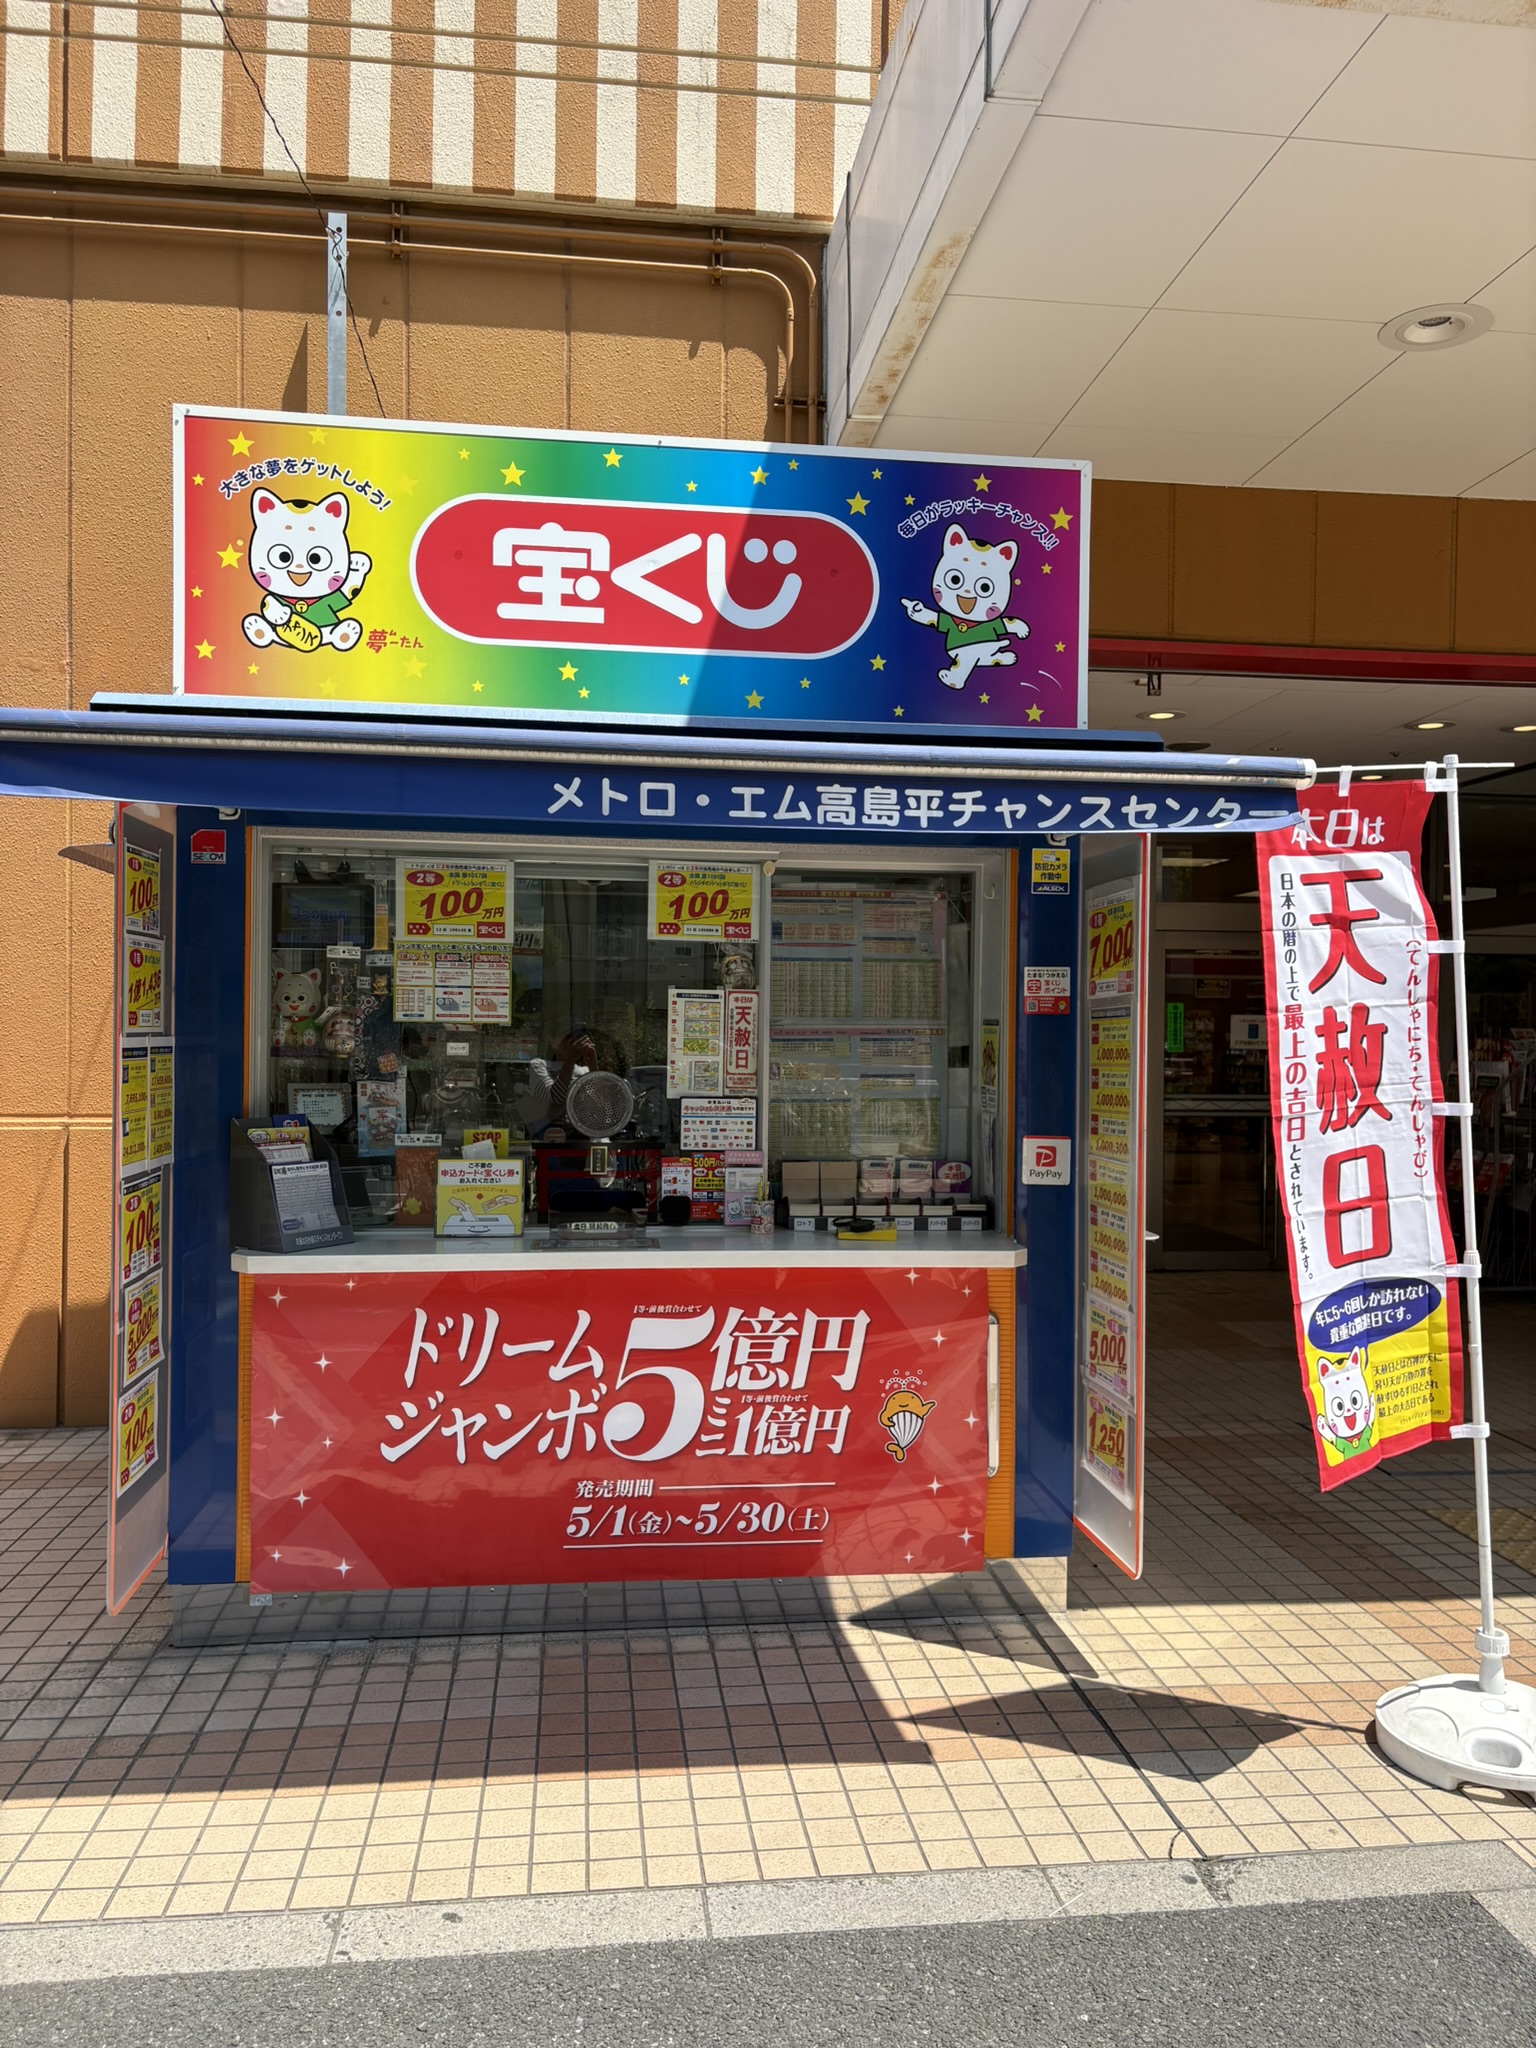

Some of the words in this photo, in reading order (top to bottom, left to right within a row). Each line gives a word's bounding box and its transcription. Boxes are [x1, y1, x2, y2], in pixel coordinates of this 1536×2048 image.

[492, 521, 803, 630] 宝くじ
[546, 776, 1290, 832] メトロ・エム高島平チャンスセンター
[1291, 808, 1385, 849] 本日は
[192, 853, 224, 861] SECOM
[1034, 863, 1068, 871] 防犯カメラ
[1040, 872, 1062, 880] 作動中
[479, 925, 504, 934] 宝くじ
[726, 926, 750, 935] 宝くじ
[734, 1006, 752, 1069] 天赦日
[1279, 872, 1314, 1280] 日本の暦の上で最上の吉日とされています。
[1300, 868, 1393, 1269] 天赦日
[1029, 1169, 1063, 1179] PayPay
[1329, 1307, 1413, 1344] 貴重な開運日です。
[404, 1307, 604, 1389] ドリーム
[1089, 1330, 1126, 1365] 5,000
[602, 1305, 872, 1462] 5億円
[380, 1382, 608, 1464] ジャンボ
[1088, 1411, 1125, 1458] 1,250
[574, 1478, 654, 1499] 発売期間
